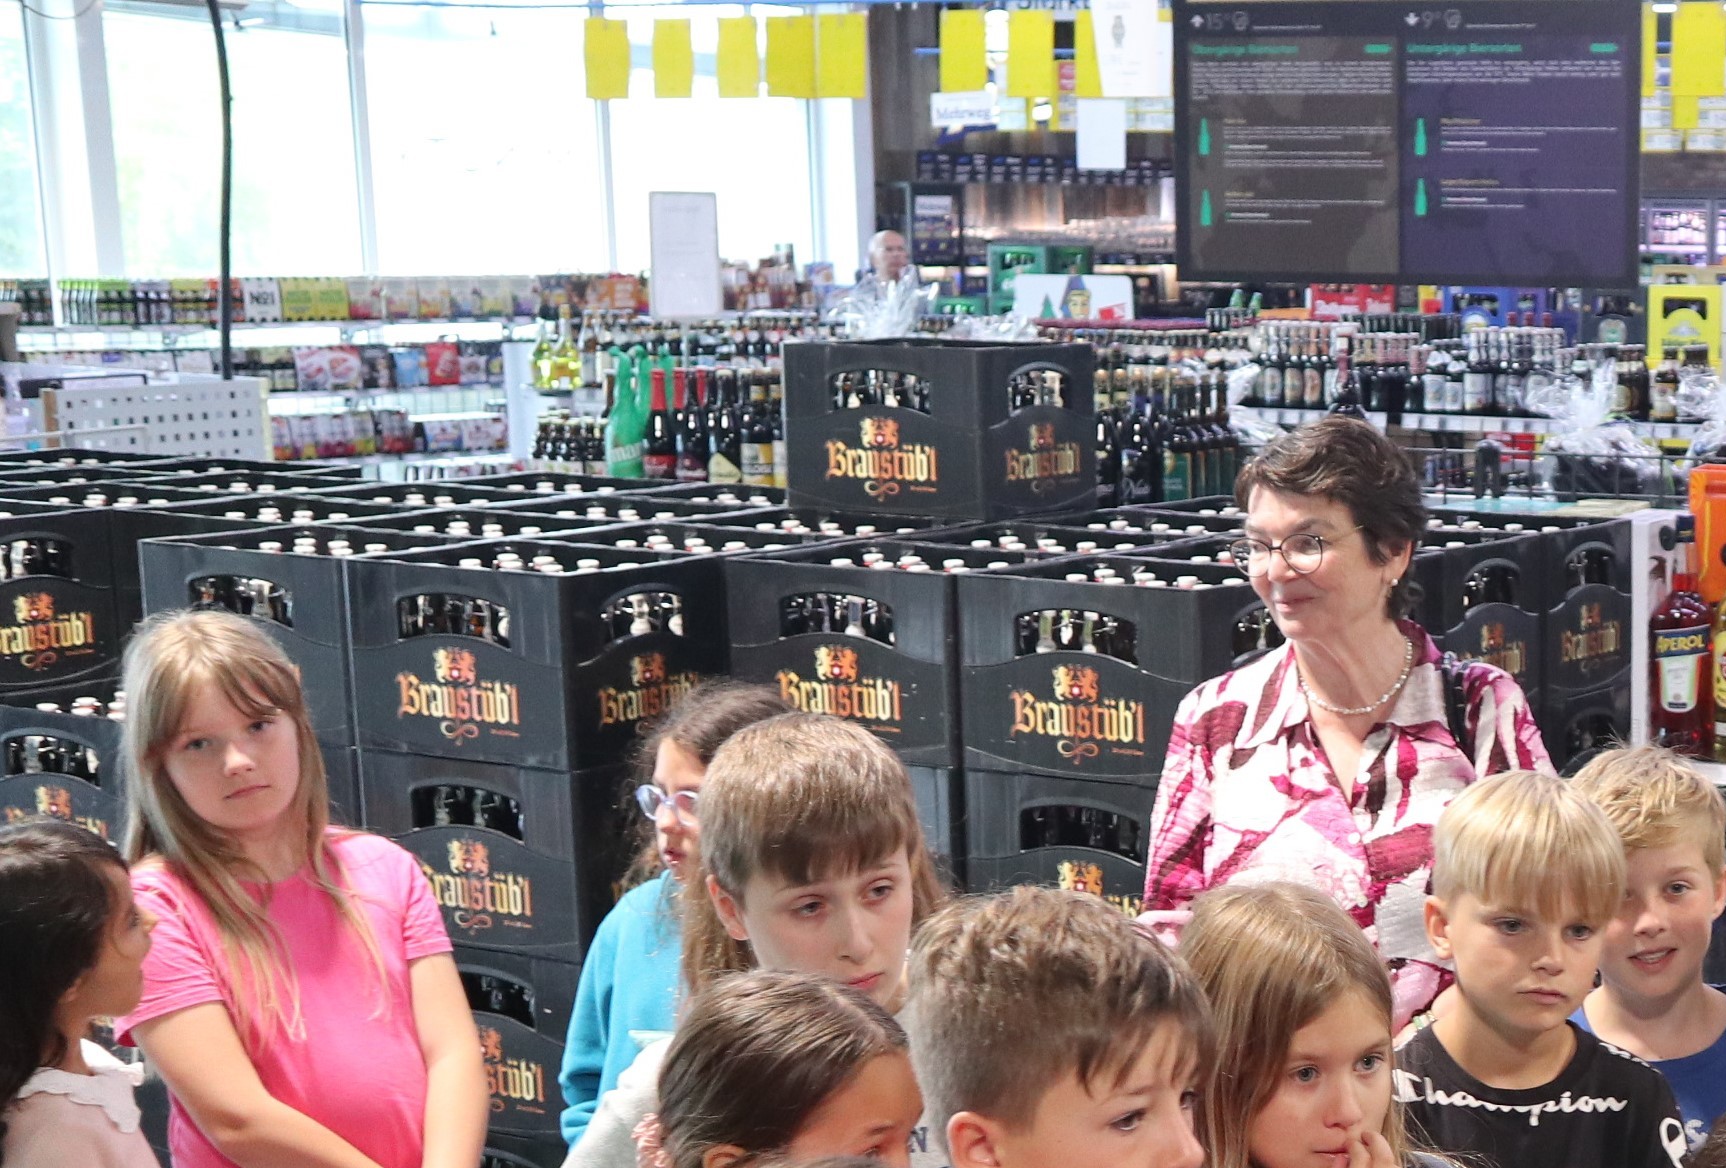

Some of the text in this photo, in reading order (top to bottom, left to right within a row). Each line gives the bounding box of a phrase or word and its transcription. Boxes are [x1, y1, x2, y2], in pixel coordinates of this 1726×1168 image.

[825, 440, 938, 482] Braustüb'l
[395, 671, 520, 725] Braustüb'l
[774, 669, 902, 721] Braustüb'l
[1010, 687, 1146, 744] Braustüb'l
[1393, 1068, 1629, 1127] Champion
